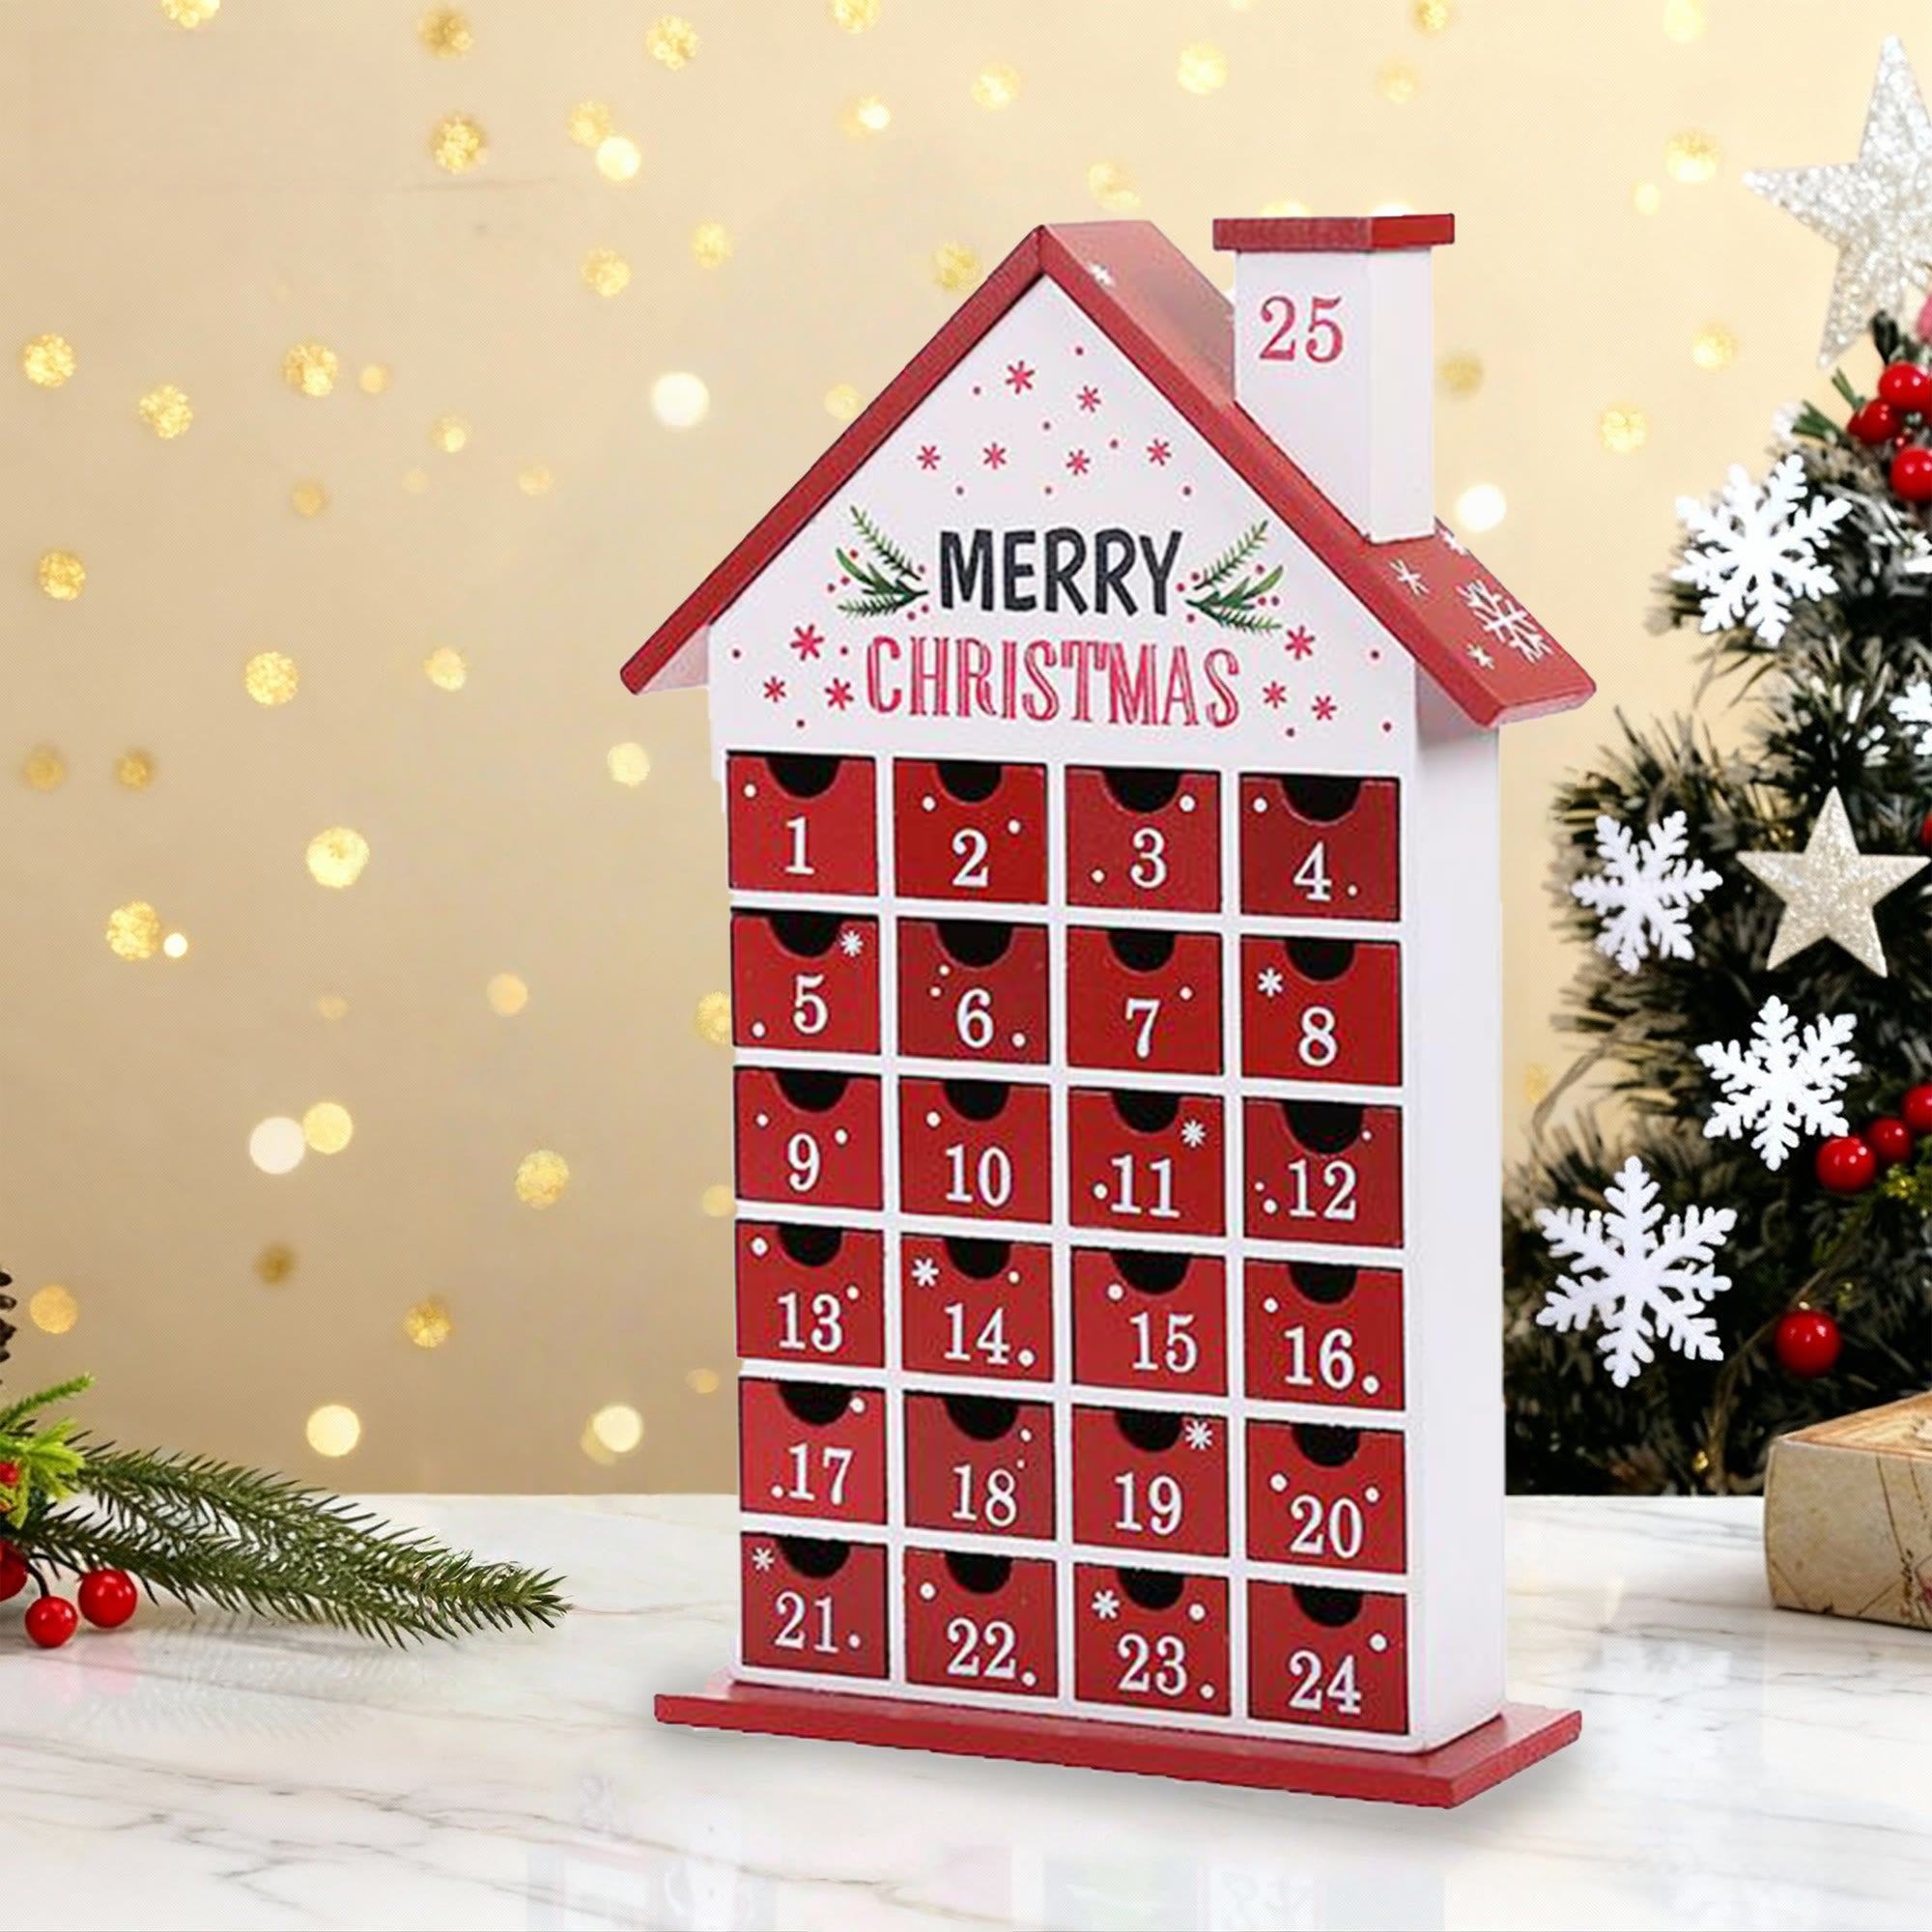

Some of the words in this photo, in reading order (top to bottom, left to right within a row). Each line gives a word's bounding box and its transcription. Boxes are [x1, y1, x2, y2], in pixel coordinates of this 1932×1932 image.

[1260, 296, 1343, 363] 25
[939, 527, 1183, 615] MERRY
[867, 636, 1240, 728] CHRISTMAS
[785, 816, 814, 875] 1
[952, 828, 988, 888] 2
[1130, 827, 1167, 889] 3
[1293, 841, 1332, 902] 4
[793, 974, 828, 1034] 5
[956, 988, 994, 1048] 6
[1125, 998, 1160, 1058] 7
[1298, 1006, 1338, 1066] 8
[788, 1133, 820, 1192] 9
[945, 1144, 1011, 1207] 10
[1111, 1154, 1180, 1218] 11
[1289, 1159, 1356, 1221] 12
[778, 1292, 842, 1352] 13
[944, 1303, 1010, 1365] 14
[1129, 1312, 1198, 1373] 15
[1284, 1326, 1354, 1390] 16
[788, 1442, 853, 1505] 17
[952, 1463, 1017, 1527] 18
[1115, 1472, 1182, 1535] 19
[1290, 1494, 1363, 1559] 20
[775, 1591, 838, 1654] 21
[947, 1617, 1016, 1680] 22
[1118, 1634, 1187, 1696] 23
[1289, 1650, 1362, 1715] 24
